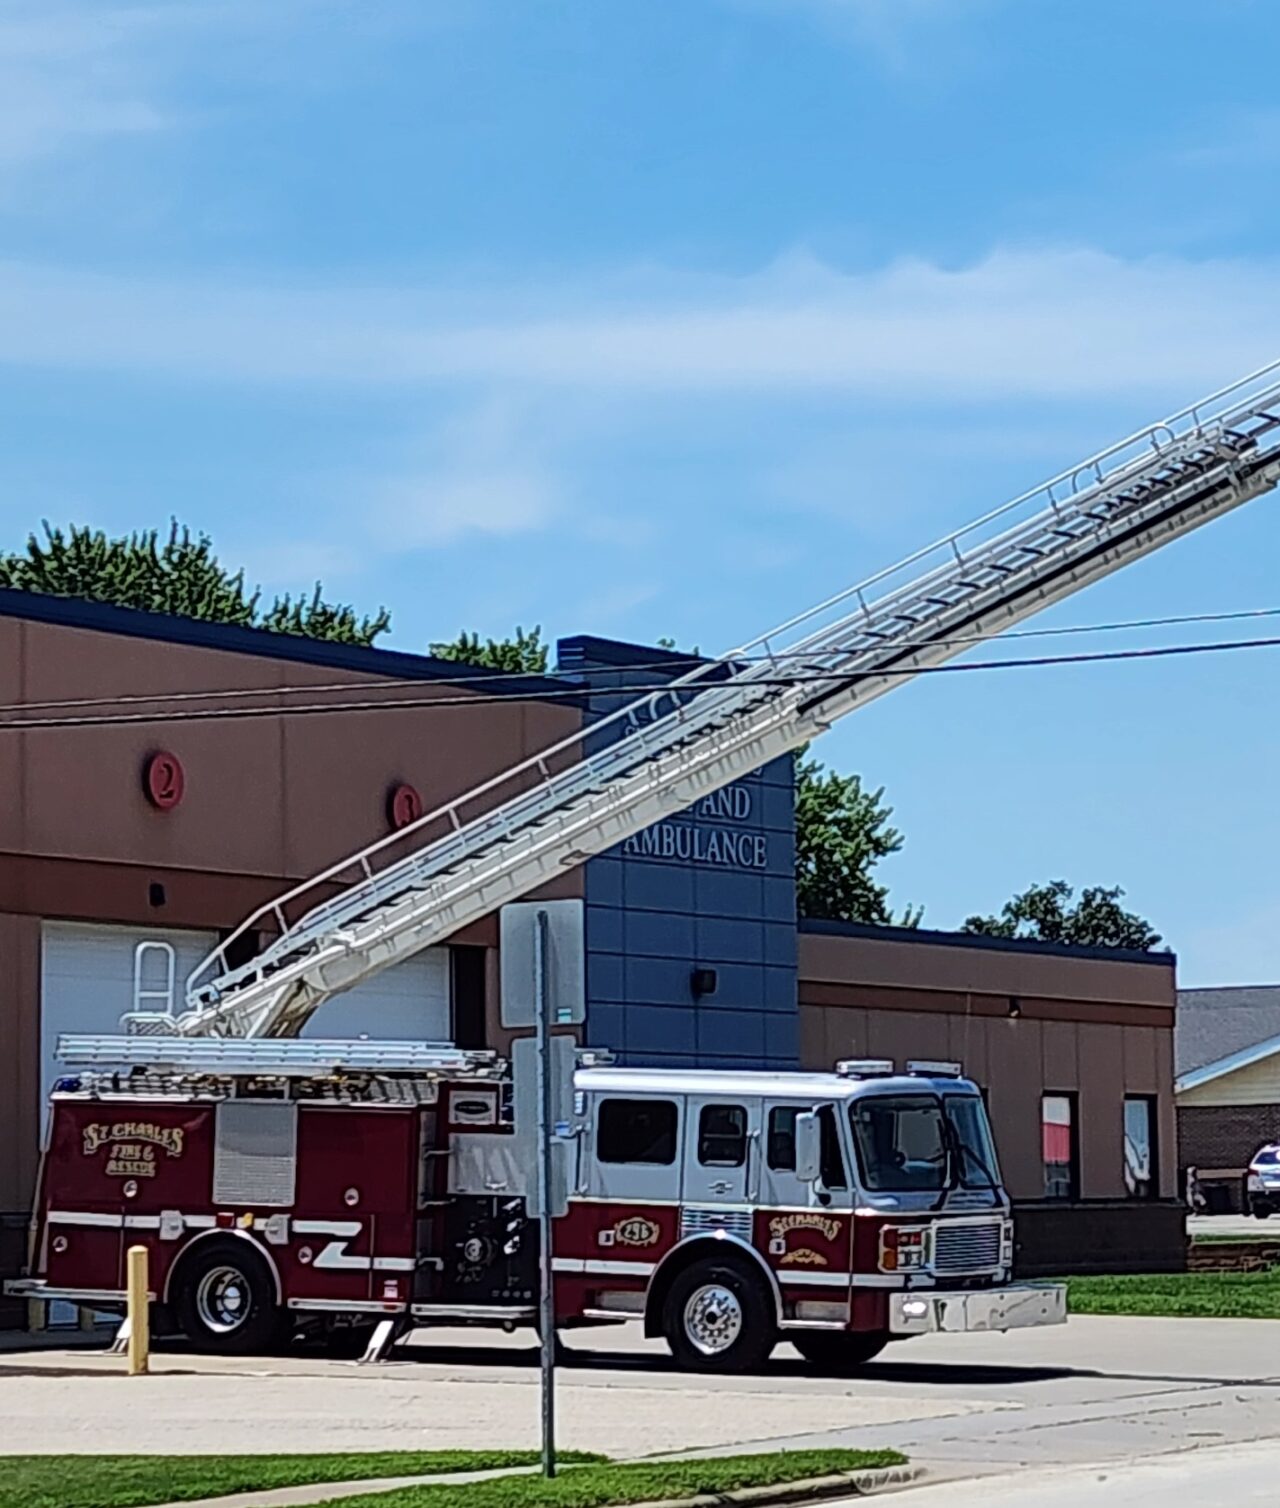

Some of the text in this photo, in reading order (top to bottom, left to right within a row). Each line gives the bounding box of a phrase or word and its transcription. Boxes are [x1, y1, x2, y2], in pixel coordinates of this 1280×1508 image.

[158, 762, 176, 799] 2
[701, 786, 751, 818] AND
[623, 824, 767, 867] AMBULANCE
[624, 1222, 650, 1241] 296
